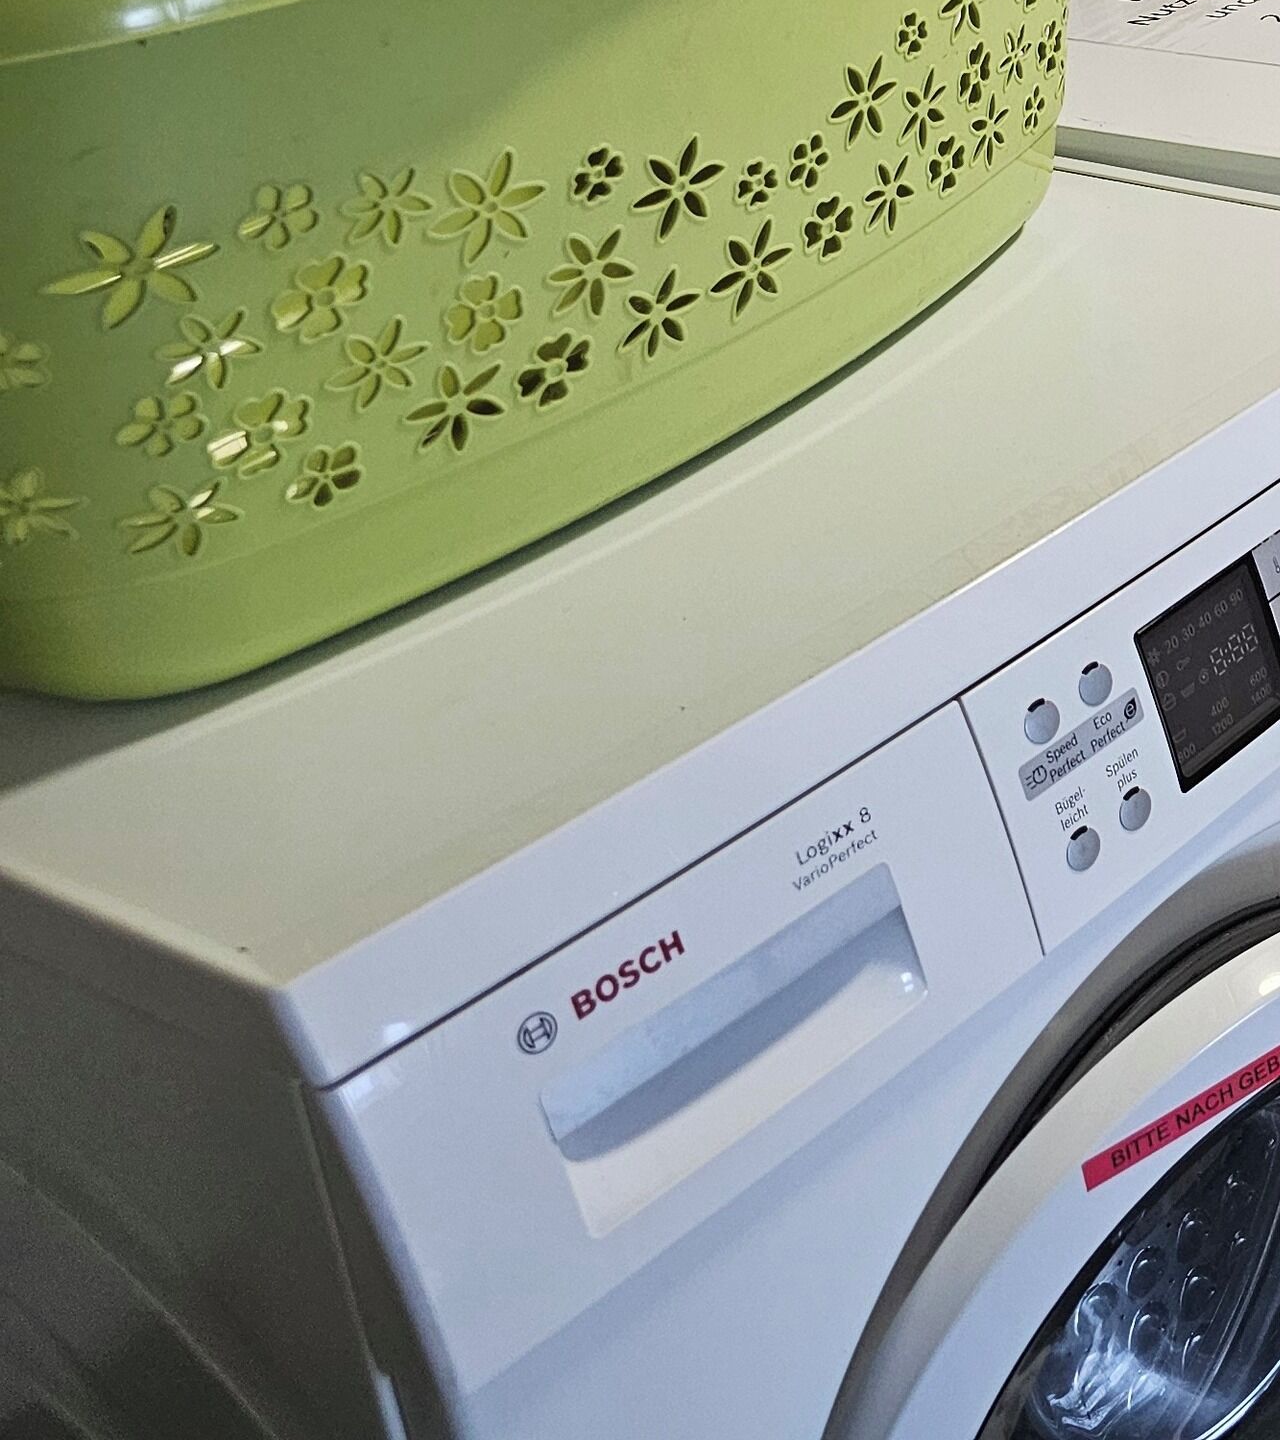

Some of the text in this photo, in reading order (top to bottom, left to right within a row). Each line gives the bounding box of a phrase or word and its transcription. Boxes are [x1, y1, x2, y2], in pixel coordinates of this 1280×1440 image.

[1164, 588, 1244, 655] 20 30 40 60 90
[1093, 711, 1112, 730] Eco
[1046, 732, 1078, 763] Speed
[1090, 721, 1126, 753] Perfect
[1049, 750, 1086, 783] Perfect
[1105, 748, 1139, 778] Spülen
[1117, 769, 1138, 791] plus
[1055, 786, 1086, 815] Bügel-
[1060, 804, 1089, 831] leicht
[795, 807, 872, 866] Logixx 8
[792, 828, 879, 892] VarioPerfect
[570, 930, 686, 1020] BOSCH
[1111, 1121, 1170, 1169] BITTE
[1176, 1084, 1233, 1131] NACH
